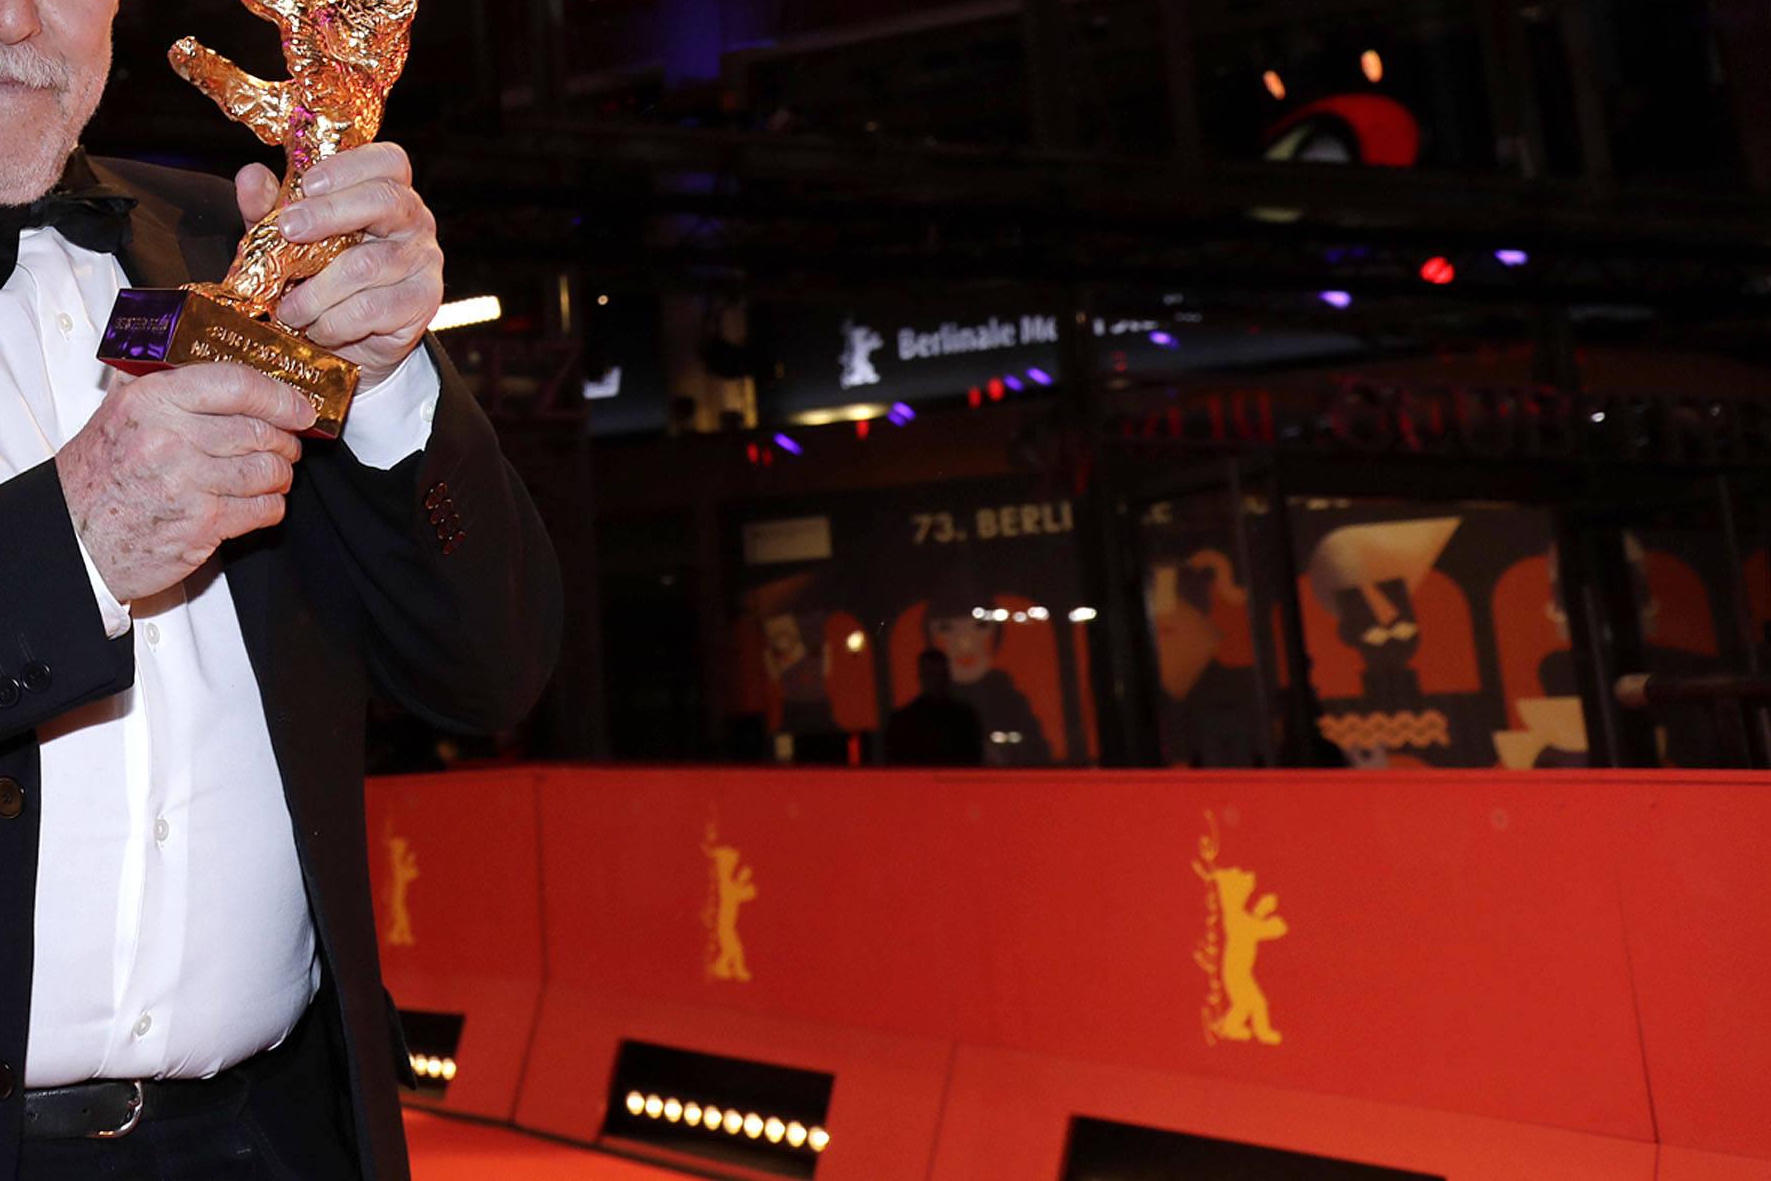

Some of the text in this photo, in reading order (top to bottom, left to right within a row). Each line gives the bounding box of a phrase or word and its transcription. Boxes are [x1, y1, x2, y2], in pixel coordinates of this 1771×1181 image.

[896, 315, 1017, 361] Berlinale
[908, 510, 969, 546] 73.
[974, 499, 1075, 541] BERLI
